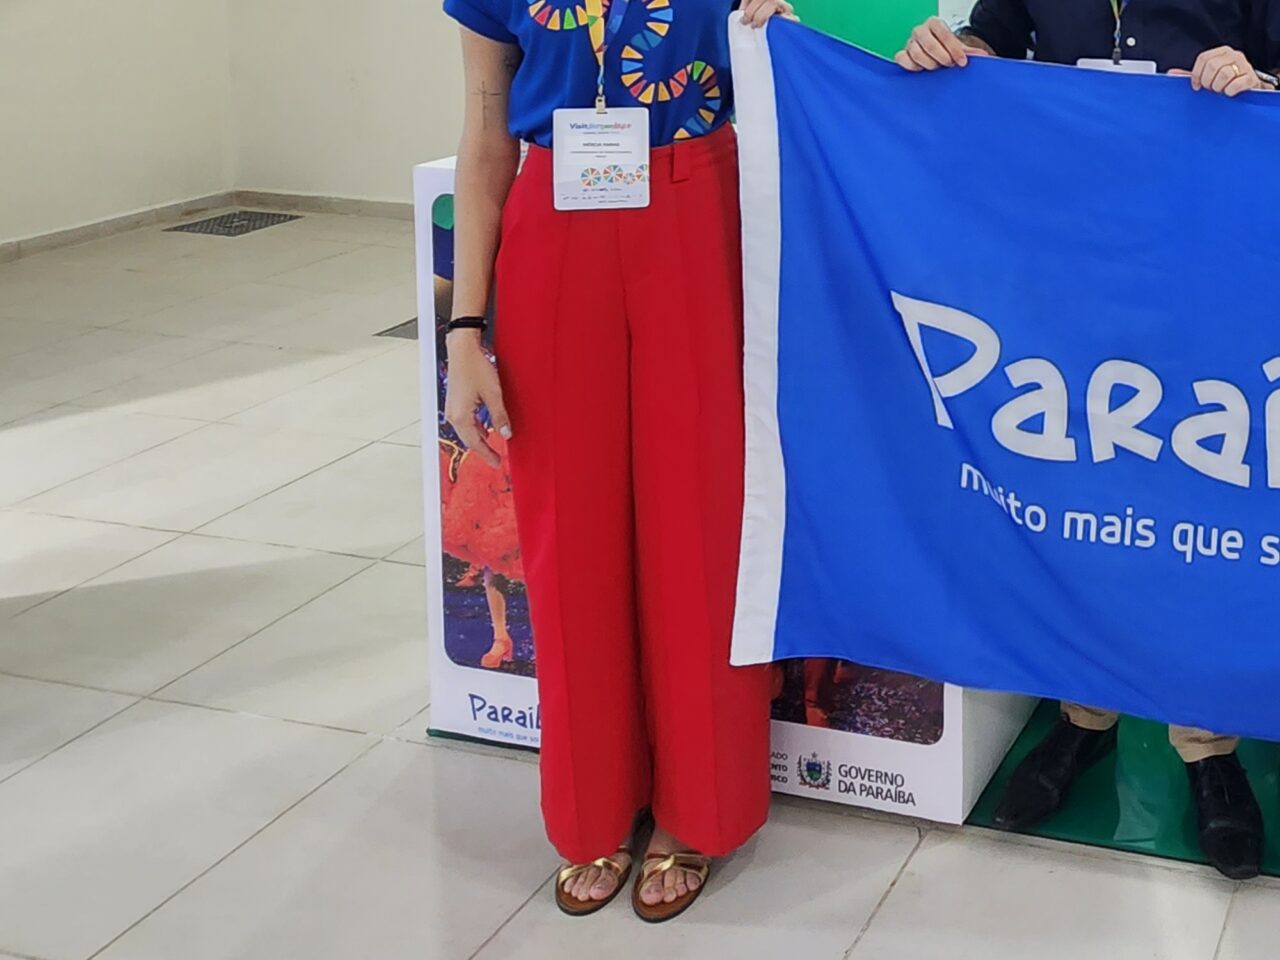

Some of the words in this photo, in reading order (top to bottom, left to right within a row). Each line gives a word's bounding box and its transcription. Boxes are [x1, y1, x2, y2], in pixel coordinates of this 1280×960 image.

[960, 461, 1047, 533] muito
[1063, 506, 1156, 548] mais
[1173, 518, 1243, 563] que
[838, 763, 905, 788] GOVERNO
[838, 780, 858, 796] DA
[859, 783, 917, 806] PARAÍBA
